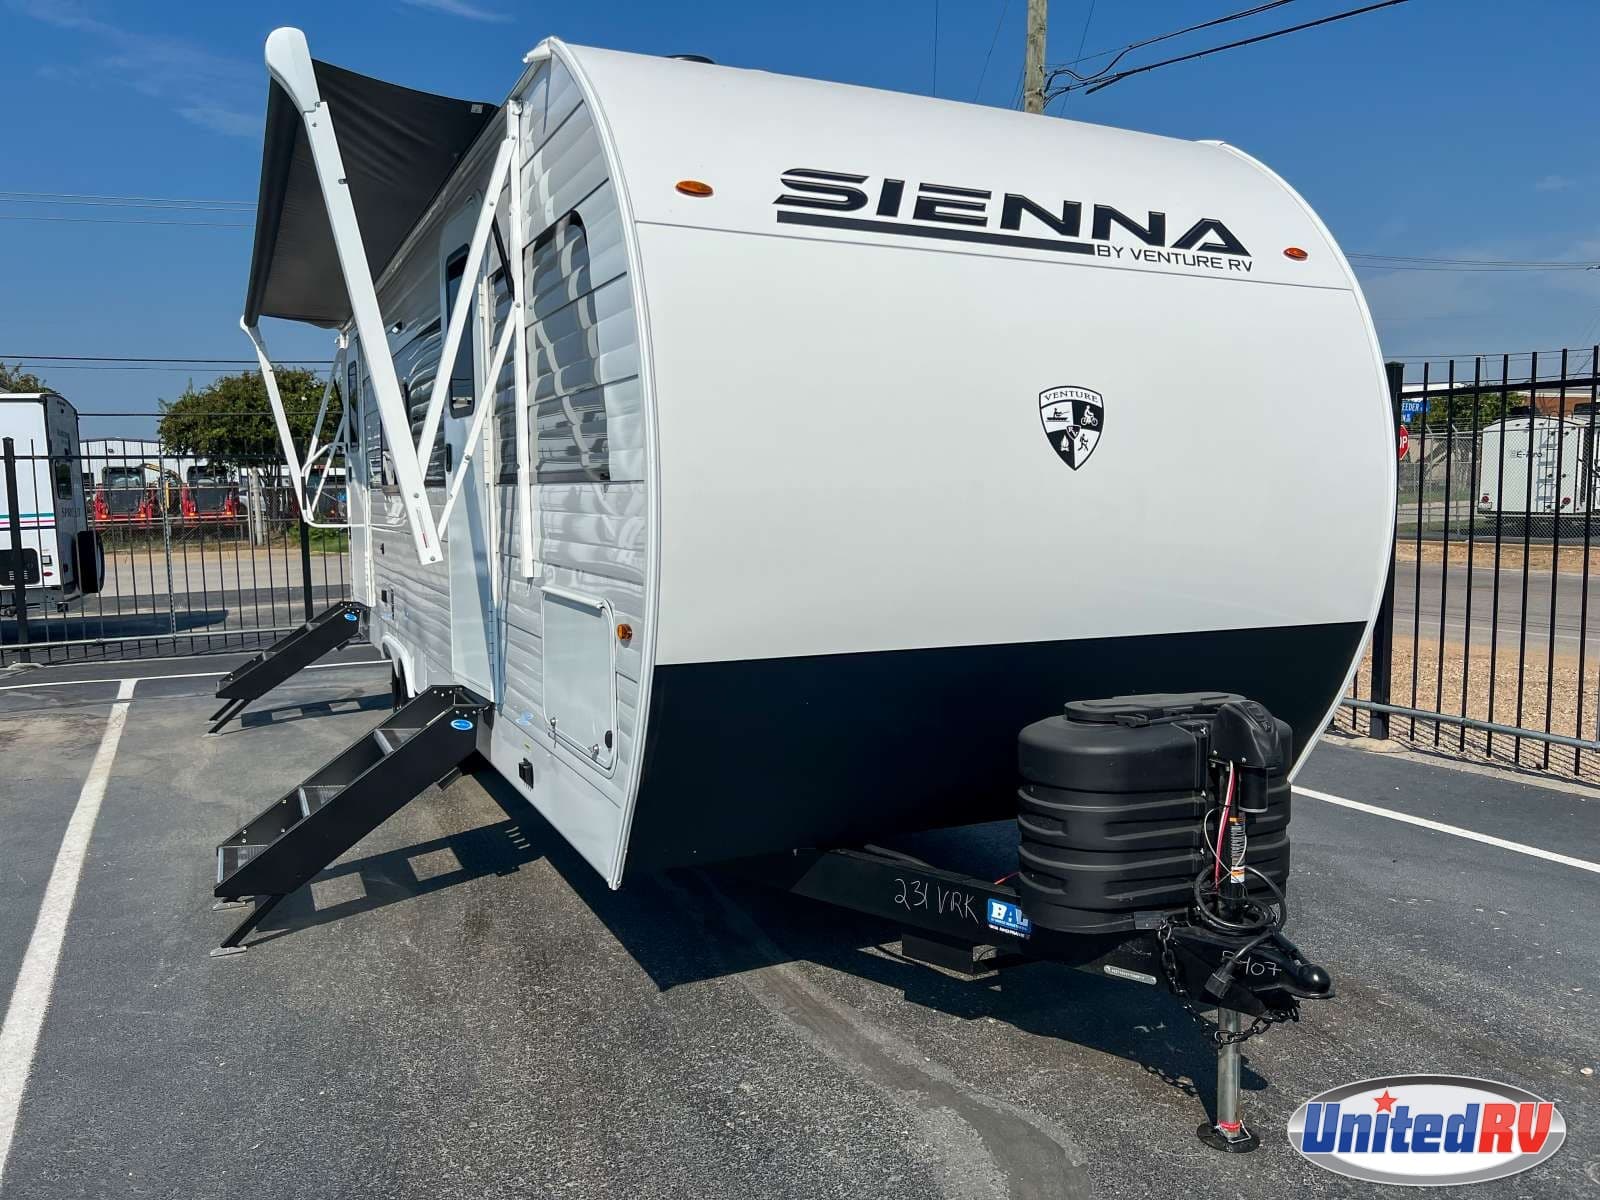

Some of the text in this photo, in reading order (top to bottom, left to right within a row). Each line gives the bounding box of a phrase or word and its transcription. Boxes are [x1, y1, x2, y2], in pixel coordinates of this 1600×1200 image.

[773, 167, 1252, 257] SIENNA
[1097, 245, 1253, 273] BY VENTURE RV
[1044, 390, 1098, 403] VENTURE
[1068, 426, 1078, 437] RV
[894, 878, 979, 924] 231 VRK
